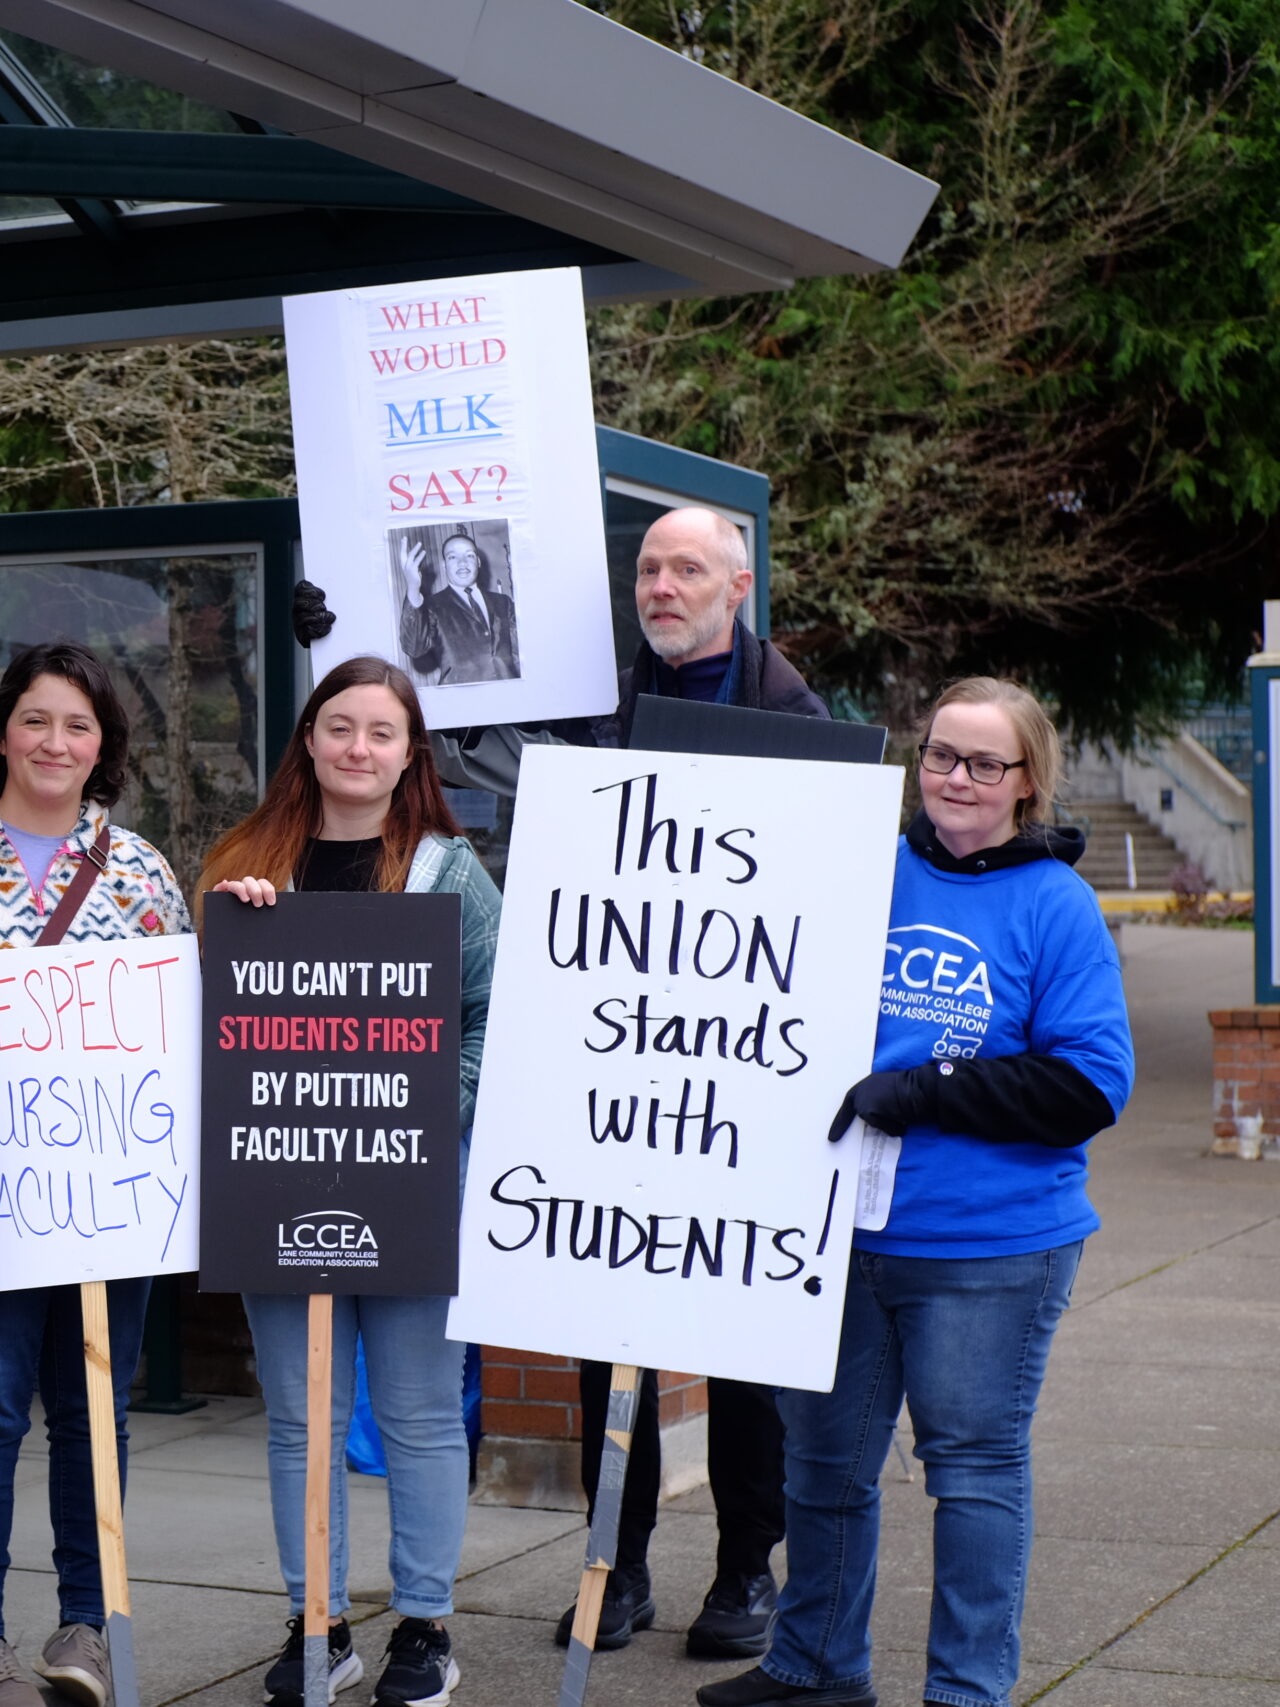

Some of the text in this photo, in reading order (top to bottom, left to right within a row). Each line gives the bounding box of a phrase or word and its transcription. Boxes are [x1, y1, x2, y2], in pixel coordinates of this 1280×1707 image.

[380, 296, 486, 332] WHAT
[368, 338, 507, 375] WOULD
[384, 393, 502, 440] MLK
[388, 464, 508, 512] SAY?
[592, 773, 759, 884] This
[548, 888, 801, 993] UNION
[231, 960, 432, 997] YOU CAN'T PUT
[882, 942, 994, 1006] CCEA
[902, 1006, 989, 1034] ASSOCIATION
[934, 997, 992, 1020] COLLEGE
[219, 1015, 444, 1052] STUDENTS FIRST
[251, 1072, 408, 1108] BY PUTTING
[231, 1126, 427, 1164] FACULTY LAST.
[278, 1223, 378, 1249] LCCEA
[298, 1250, 343, 1258] COMMUNITY
[344, 1251, 378, 1259] COLLEGE
[278, 1258, 378, 1267] EDUCATION ASSOCIATION
